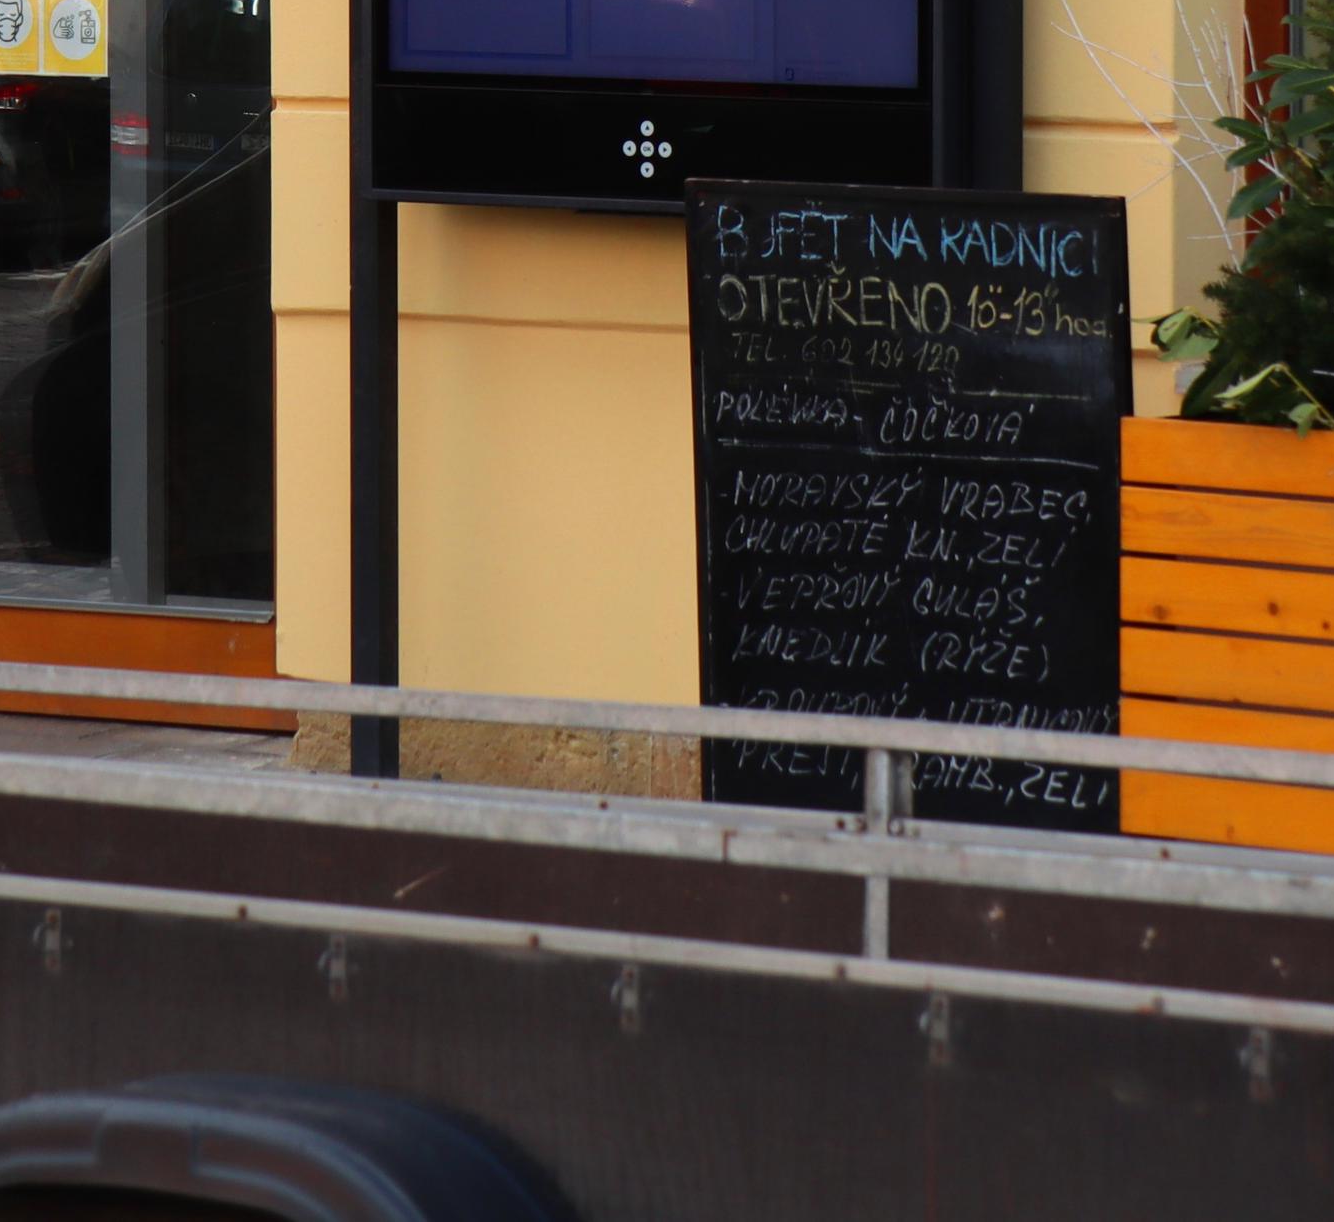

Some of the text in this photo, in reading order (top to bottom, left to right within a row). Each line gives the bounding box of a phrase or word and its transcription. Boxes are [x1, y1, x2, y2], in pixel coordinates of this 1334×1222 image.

[869, 212, 927, 263] NA
[717, 262, 952, 334] OTEVŘENO
[730, 331, 788, 363] TEL.
[940, 475, 1092, 526] VRABEC,
[724, 513, 889, 555] CHLUPATÉ
[731, 617, 1051, 683] KNEDLÍK (RÝŽE)
